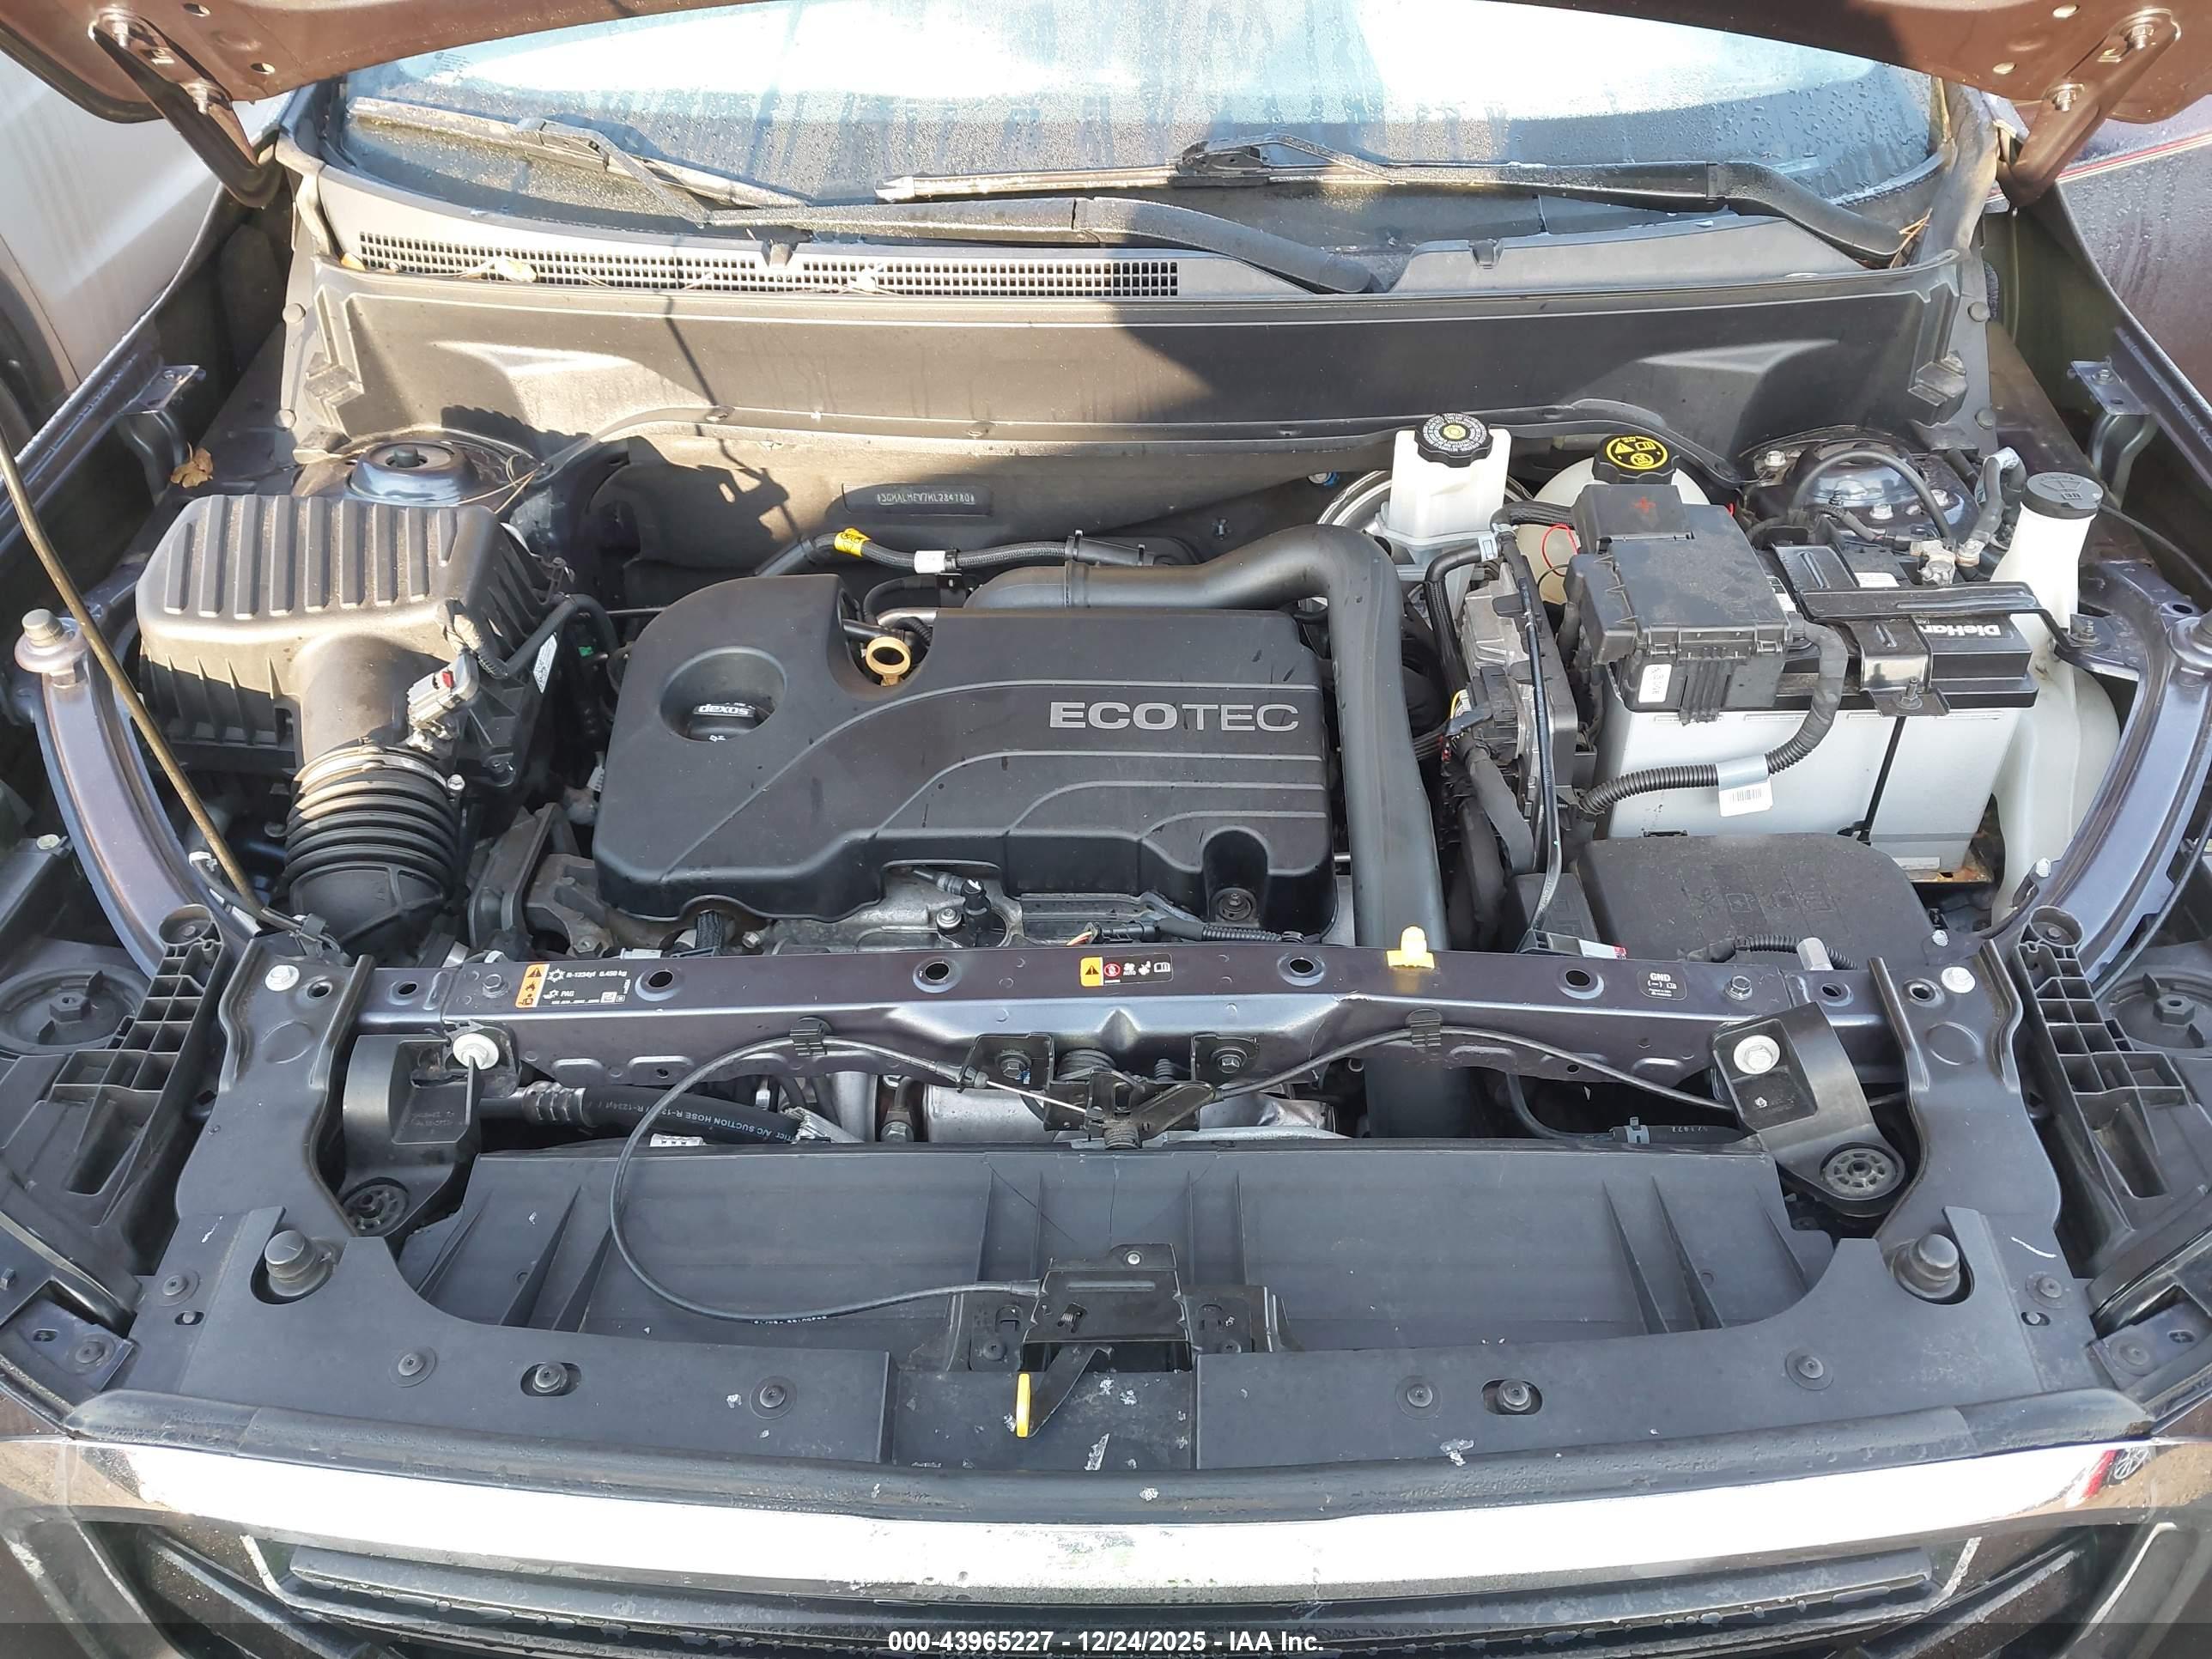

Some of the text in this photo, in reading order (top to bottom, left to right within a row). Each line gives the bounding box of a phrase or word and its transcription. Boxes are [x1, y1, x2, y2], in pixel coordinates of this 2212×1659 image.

[1917, 624, 2002, 636] DieHar
[698, 703, 749, 715] dexos
[1050, 702, 1300, 732] ECOTEC
[1650, 972, 1671, 982] GND
[684, 1111, 713, 1124] HOSE
[714, 1118, 756, 1133] SUCTION
[757, 1125, 774, 1138] A/C
